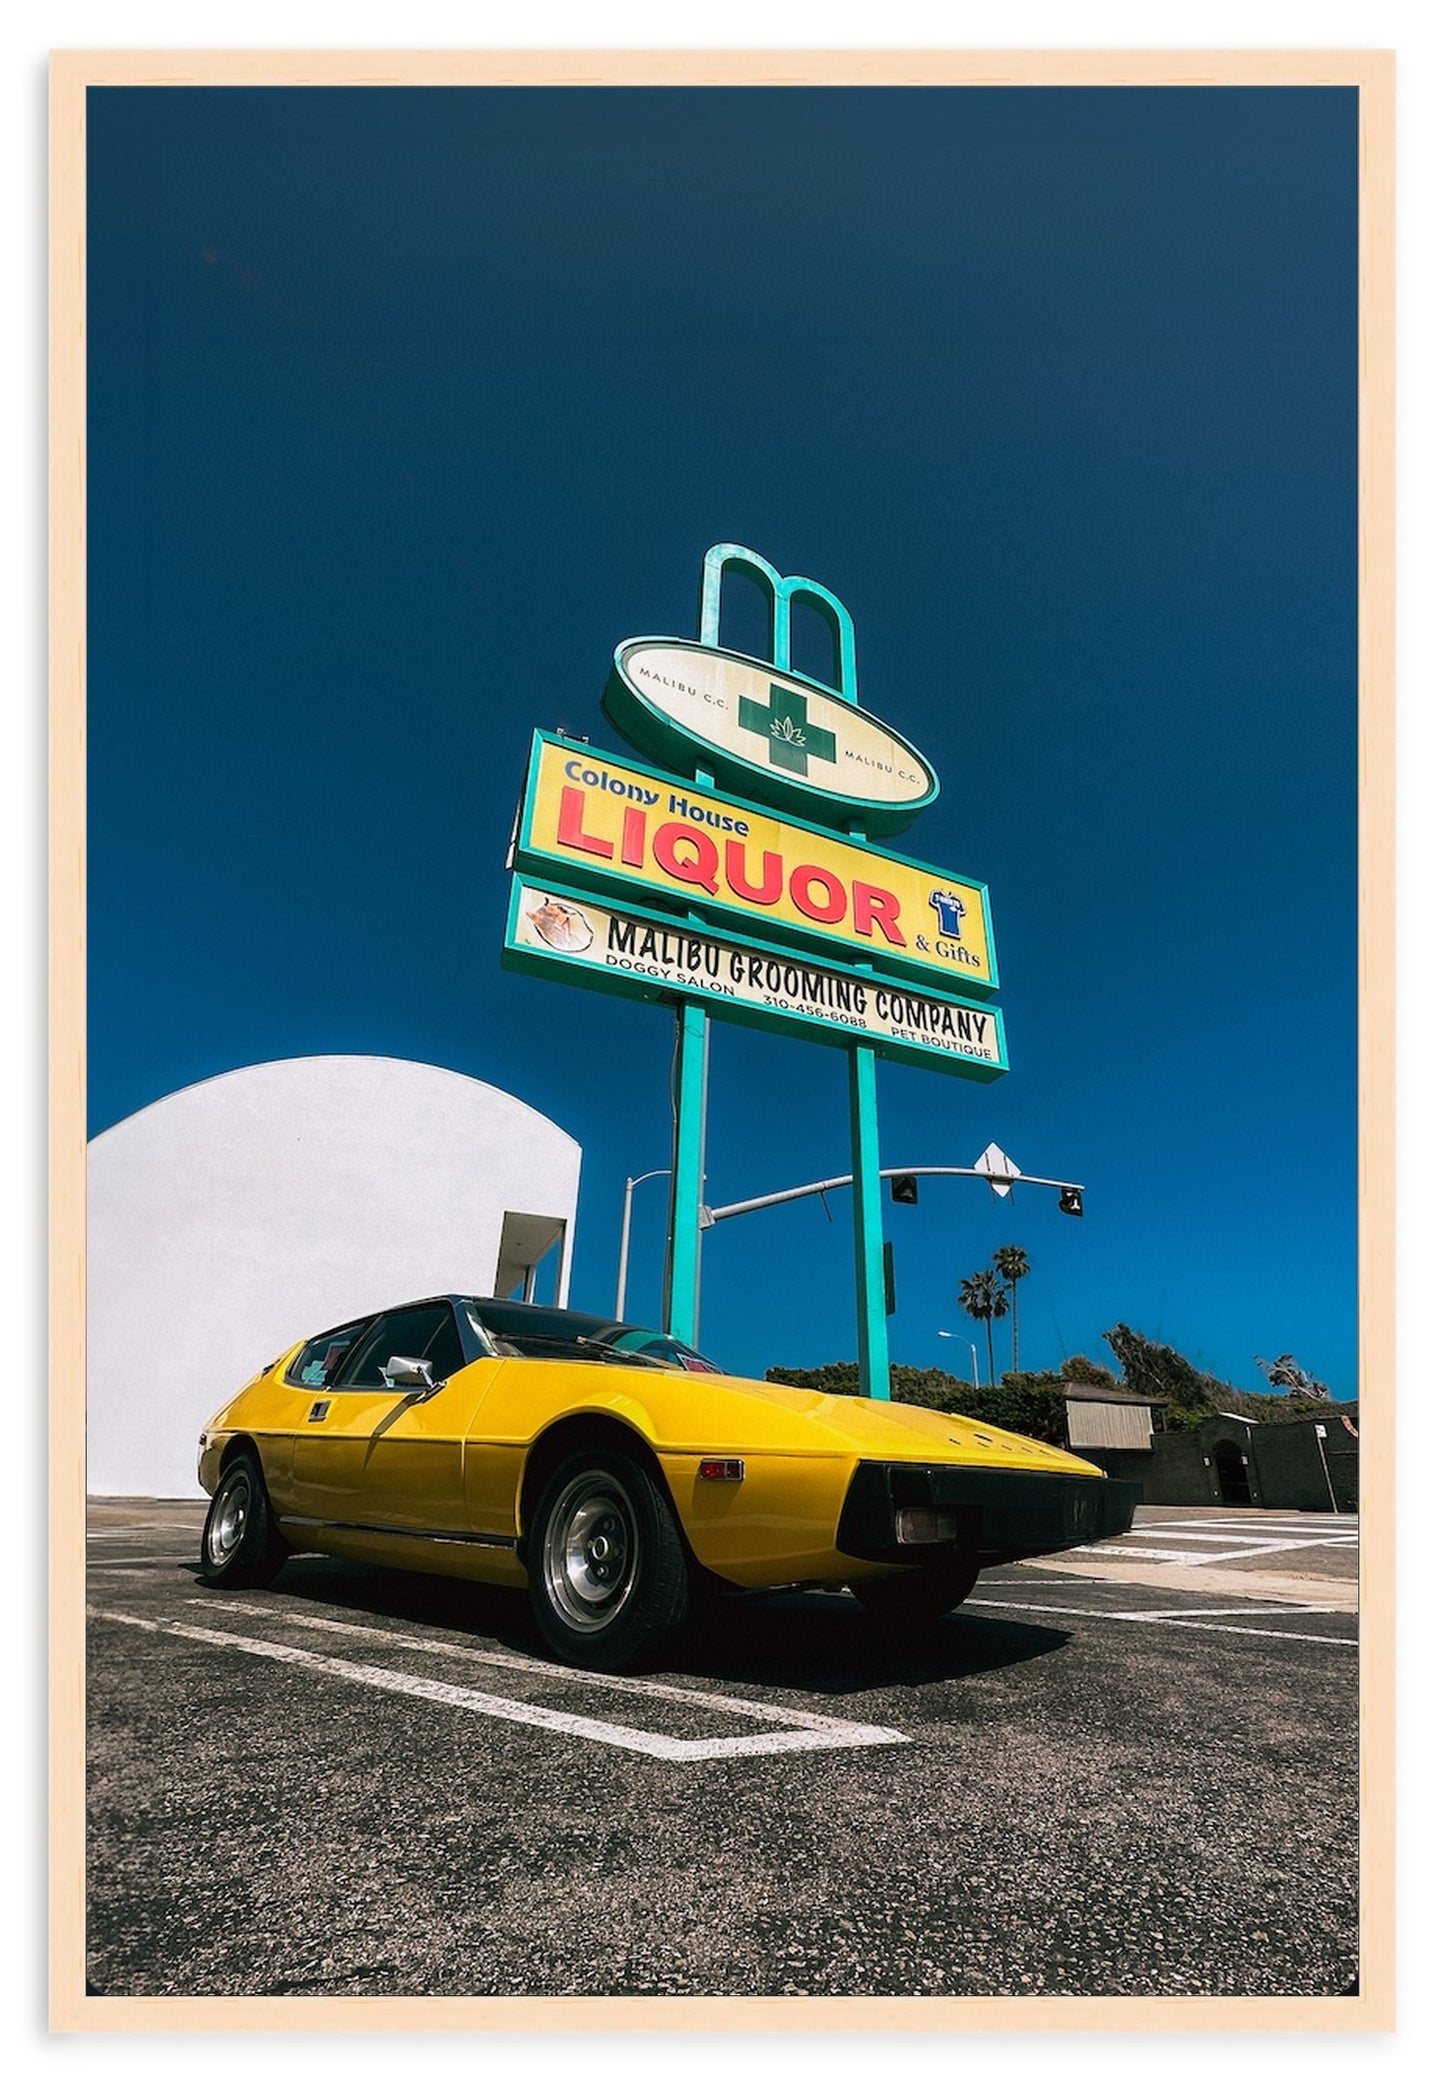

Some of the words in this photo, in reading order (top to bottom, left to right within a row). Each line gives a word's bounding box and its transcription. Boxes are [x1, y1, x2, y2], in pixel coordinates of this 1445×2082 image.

[639, 667, 697, 697] MALIBU
[703, 693, 729, 711] C.C.
[844, 750, 893, 774] MALIBU
[898, 769, 921, 785] C.C.
[564, 760, 660, 806] Colony
[668, 795, 750, 837] House
[557, 785, 907, 947] LIQUOR
[915, 934, 931, 953] &
[935, 940, 981, 968] Gifts
[605, 953, 672, 981] DOGGY
[675, 972, 736, 997] SALON
[607, 915, 721, 978] MALIBU
[729, 951, 868, 1017] GROOMING
[875, 990, 988, 1045] COMPANY
[762, 993, 868, 1030] 310-456-6088
[890, 1026, 918, 1043] PET
[921, 1032, 993, 1060] BOUTIQUE
